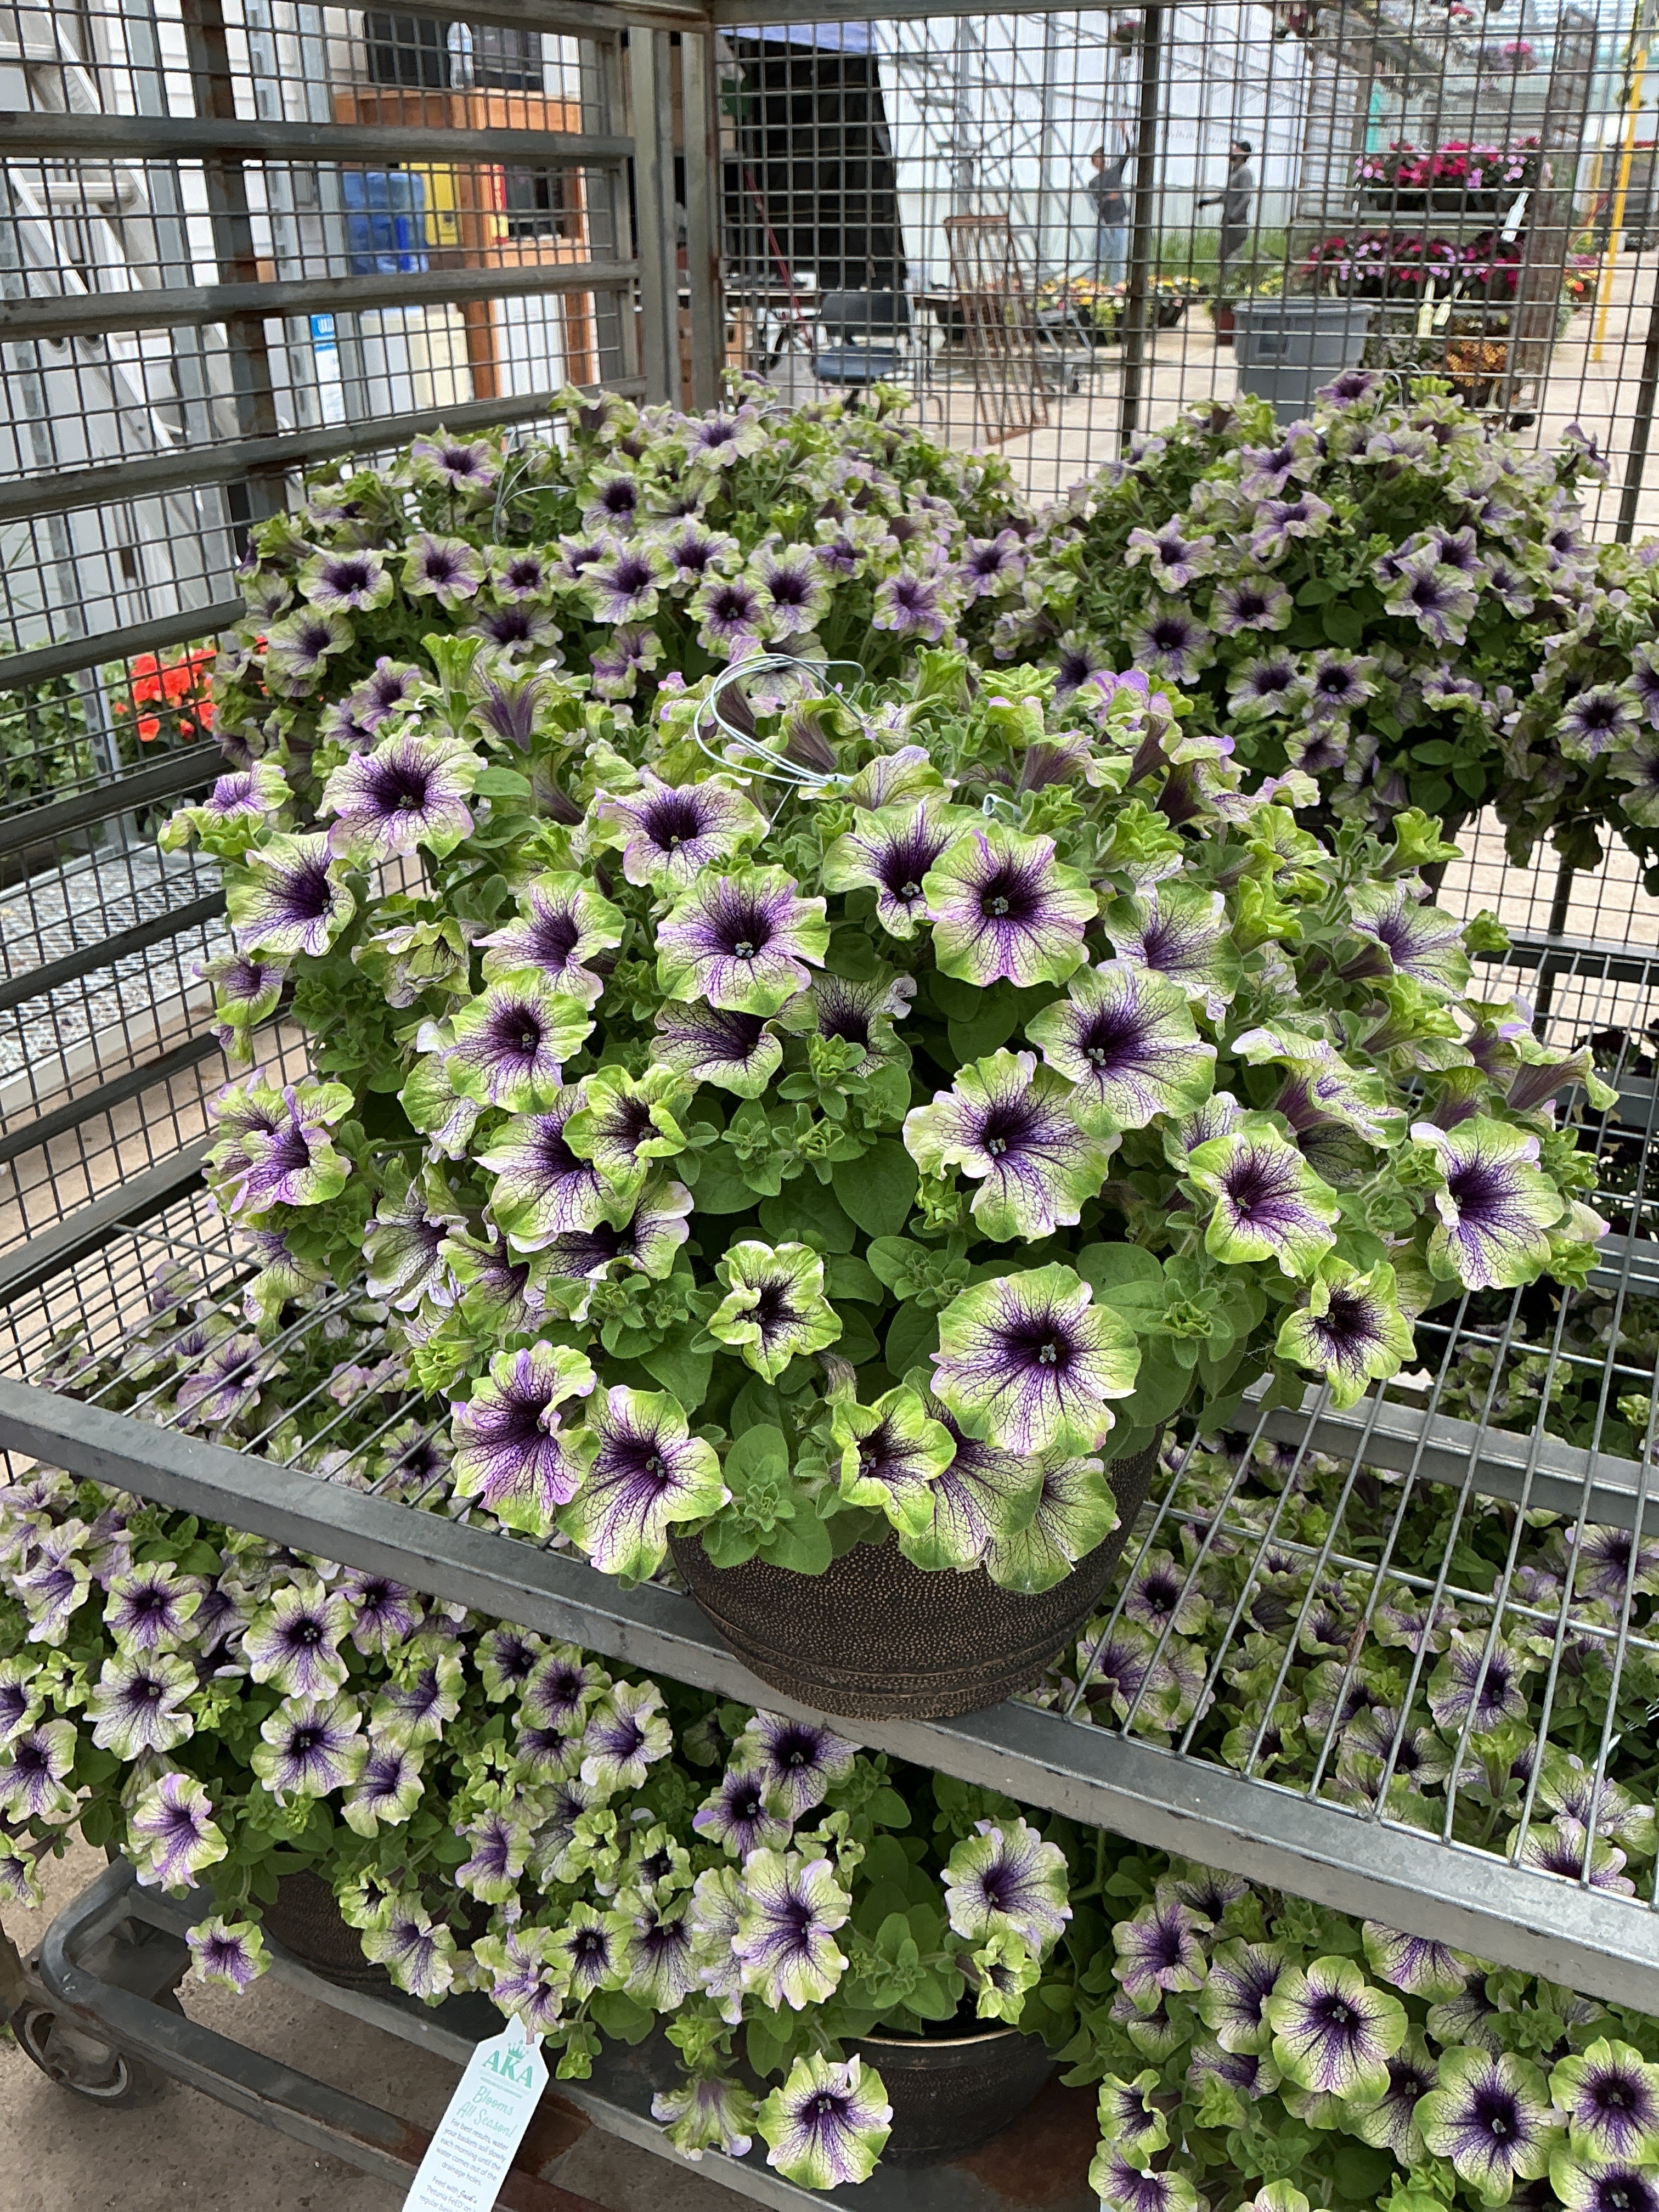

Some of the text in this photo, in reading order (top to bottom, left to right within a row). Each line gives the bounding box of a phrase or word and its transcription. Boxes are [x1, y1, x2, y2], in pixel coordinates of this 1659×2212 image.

[482, 2050, 533, 2089] AKA
[472, 2086, 514, 2115] Blooms
[451, 2118, 460, 2127] For
[460, 2123, 473, 2134] best
[493, 2140, 509, 2151] water
[456, 2102, 518, 2138] All Season!
[441, 2138, 501, 2172] each morning until the
[443, 2128, 458, 2137] your
[488, 2149, 506, 2163] slowly
[436, 2147, 452, 2158] water
[452, 2155, 470, 2168] comes
[470, 2165, 481, 2173] out
[487, 2172, 497, 2182] the
[442, 2162, 465, 2178] drainage
[432, 2176, 447, 2188] Feed
[446, 2185, 459, 2194] with
